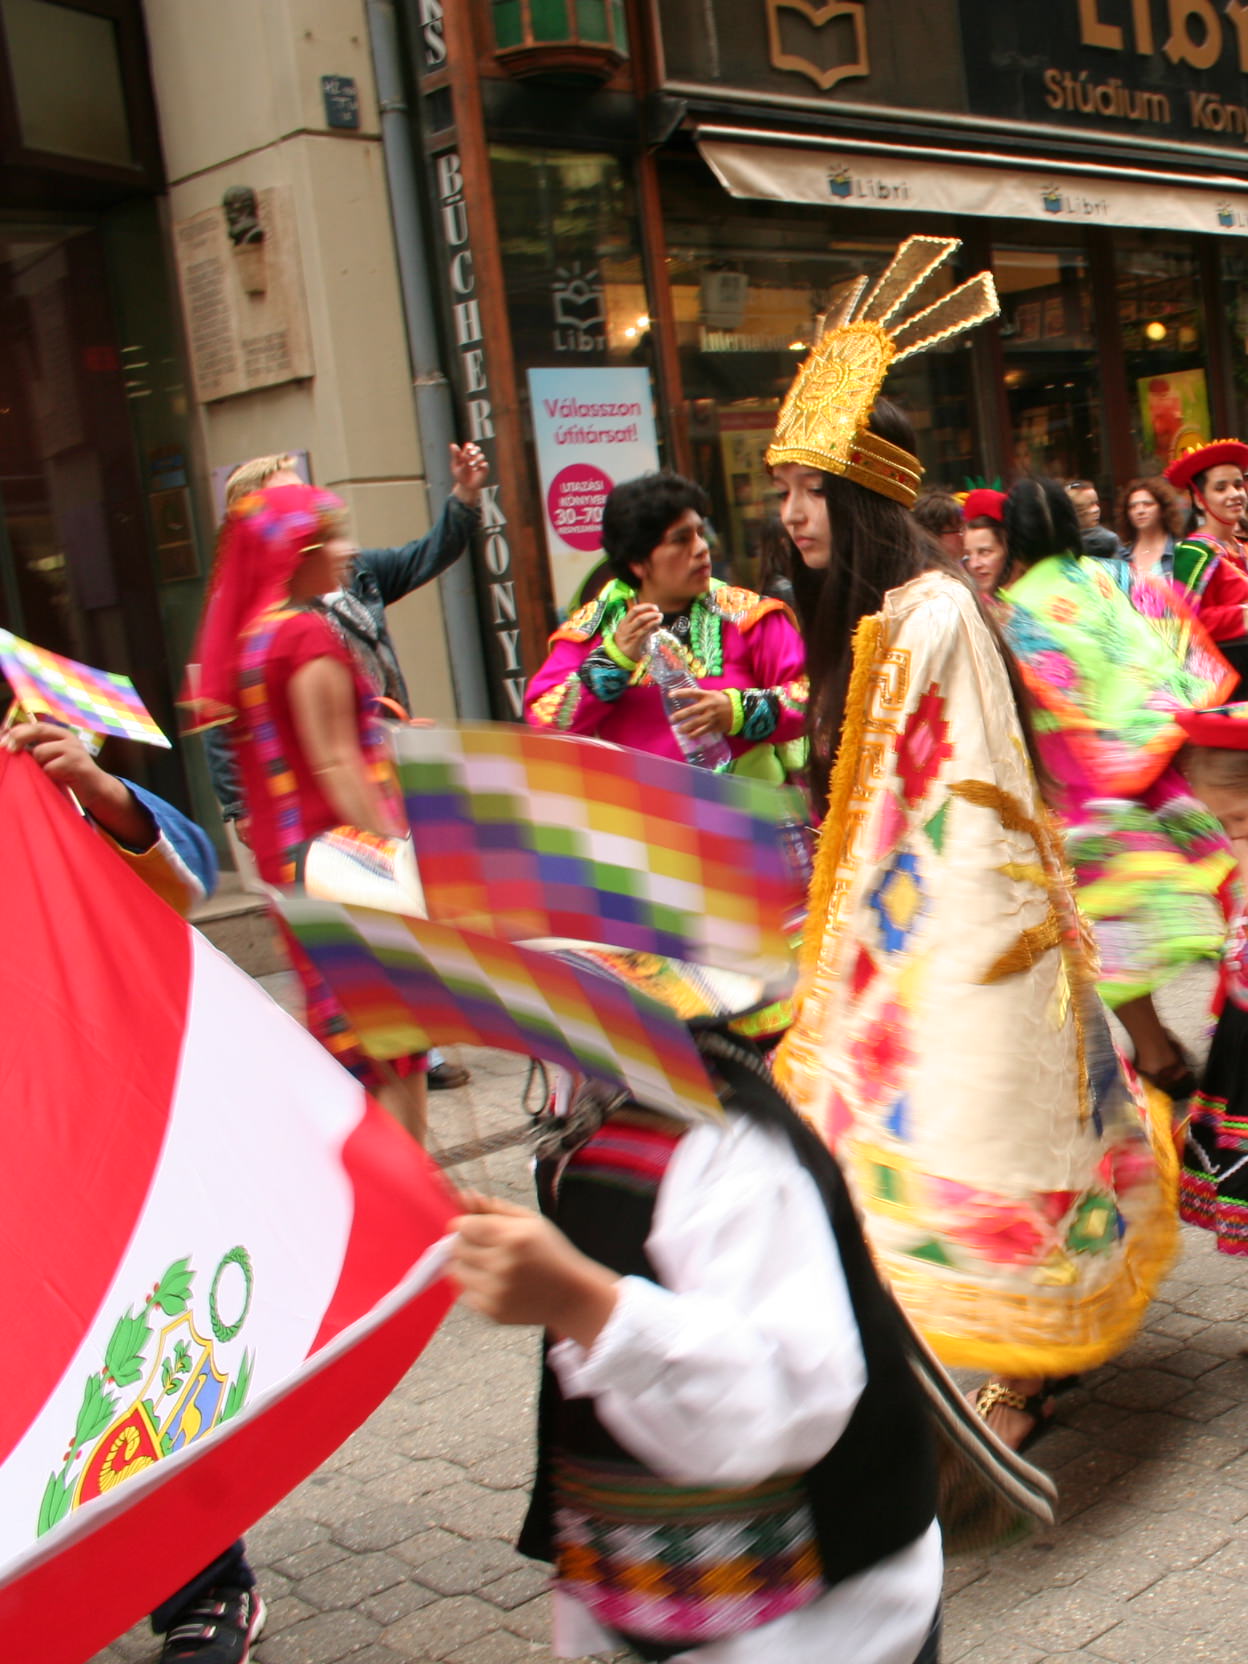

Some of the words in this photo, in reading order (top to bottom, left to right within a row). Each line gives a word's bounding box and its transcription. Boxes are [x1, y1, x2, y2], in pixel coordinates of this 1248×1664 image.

[1042, 67, 1172, 124] Stúdium
[855, 178, 910, 200] Libri
[1064, 198, 1111, 216] Libri
[436, 153, 496, 442] BÜCHER
[543, 398, 642, 419] Válasszon
